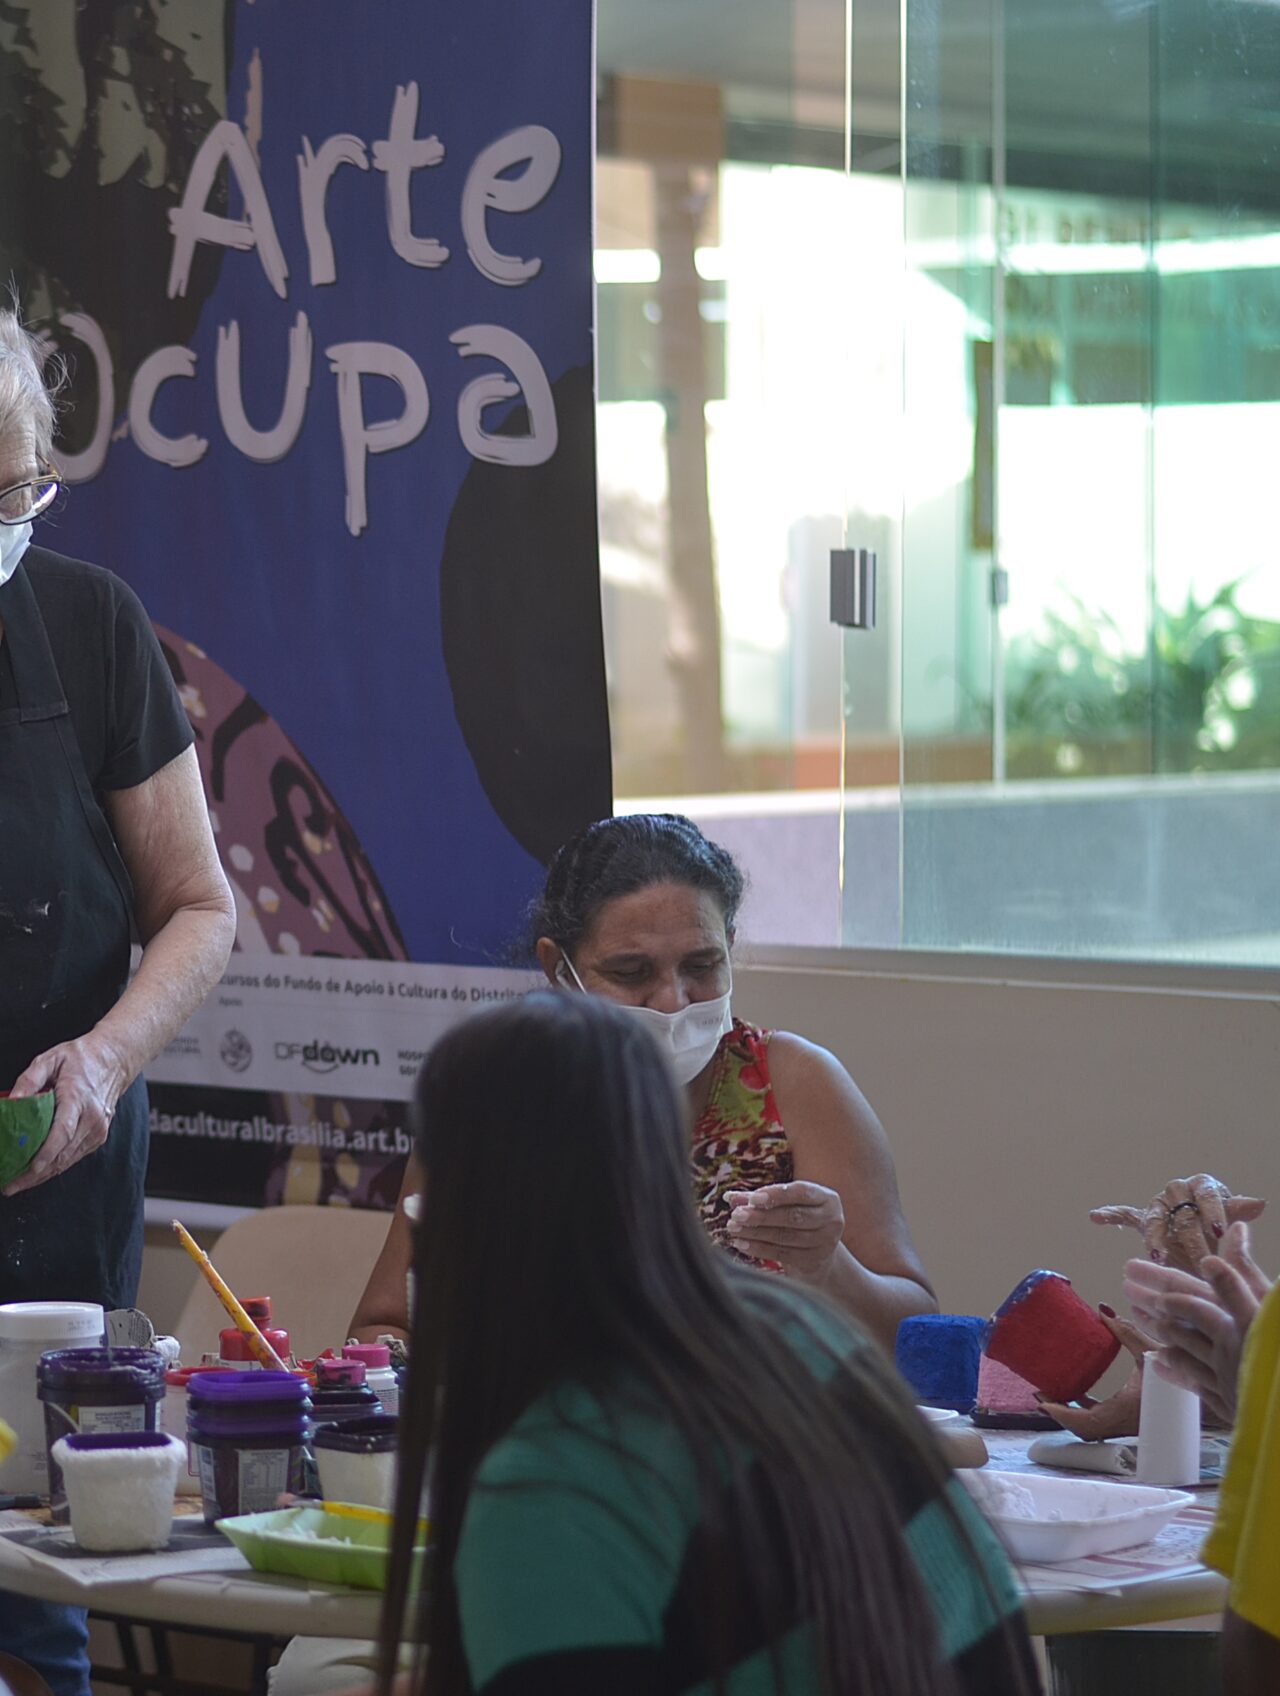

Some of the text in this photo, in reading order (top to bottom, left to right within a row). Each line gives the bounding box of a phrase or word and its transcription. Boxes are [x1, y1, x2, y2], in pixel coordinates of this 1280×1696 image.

[167, 81, 562, 299] Arte
[37, 310, 559, 536] Ocupa
[264, 974, 281, 989] do
[284, 975, 322, 991] Fundo
[325, 979, 340, 993] de
[344, 980, 384, 996] Apoio
[398, 983, 448, 1000] Cultura
[451, 985, 467, 1001] do
